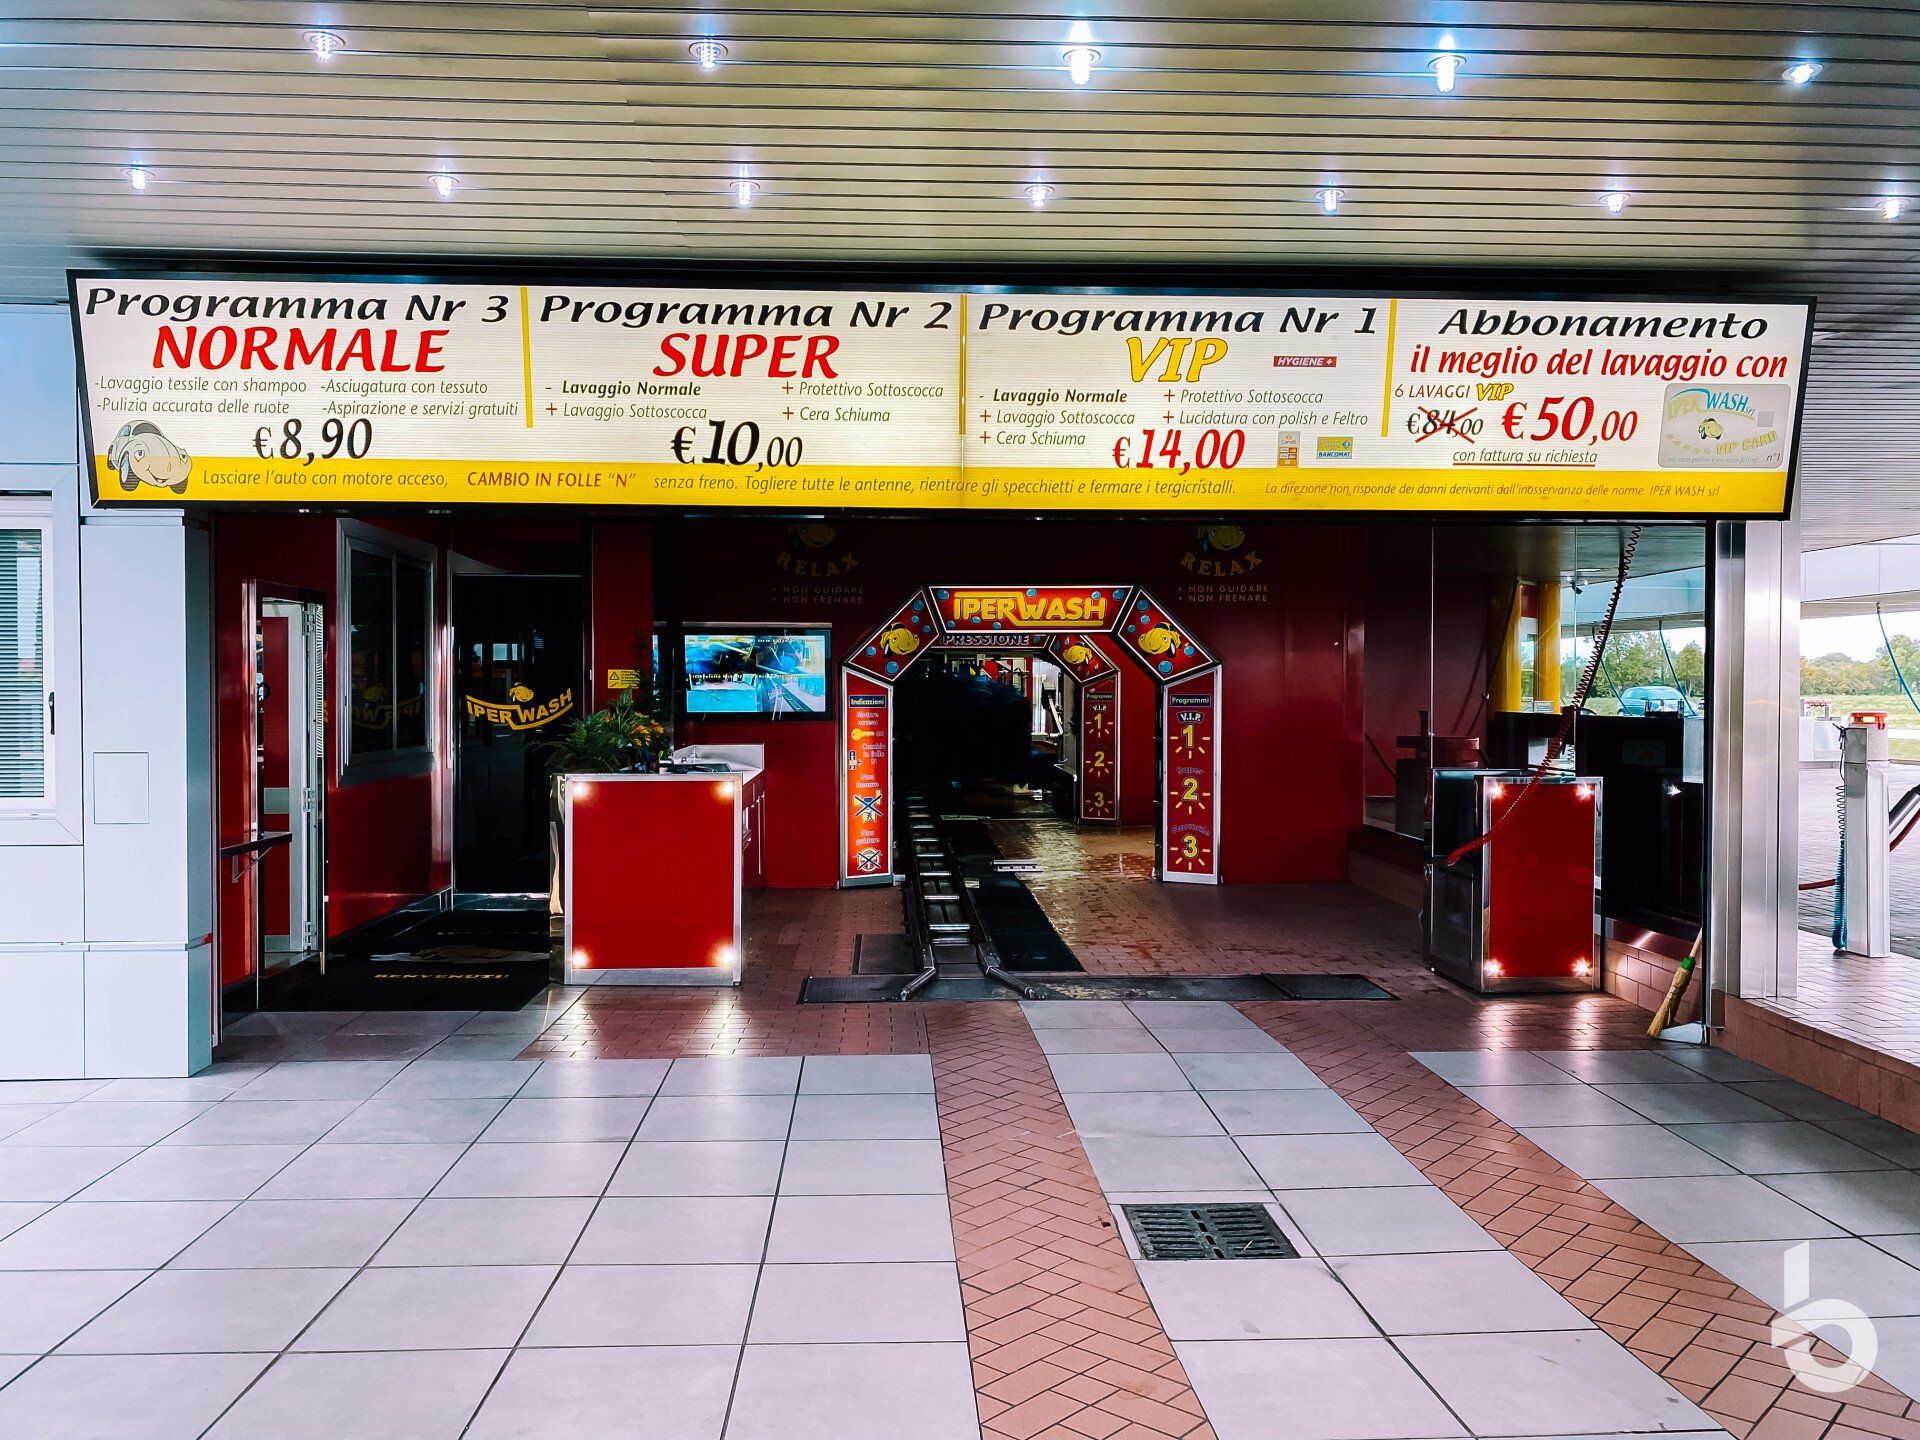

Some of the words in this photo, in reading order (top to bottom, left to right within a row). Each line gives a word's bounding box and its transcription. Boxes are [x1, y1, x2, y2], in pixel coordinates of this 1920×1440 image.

[86, 288, 387, 322] Programma
[405, 295, 466, 321] Nr
[481, 296, 508, 322] 3
[540, 296, 833, 328] Programma
[850, 301, 909, 327] Nr
[924, 302, 952, 329] 2
[979, 304, 1264, 335] Programma
[1280, 308, 1339, 333] Nr
[1354, 308, 1376, 334] 1
[1438, 309, 1767, 339] Abbonamento
[153, 326, 449, 372] NORMALE
[653, 333, 839, 379] SUPER
[1126, 337, 1228, 383] VIP
[1277, 357, 1324, 367] HYGIENE
[1411, 344, 1430, 372] il
[1438, 346, 1538, 378] meglio
[1547, 348, 1593, 375] del
[1601, 349, 1727, 381] lavaggio
[1736, 356, 1787, 377] con
[169, 377, 208, 390] tessile
[214, 381, 237, 391] con
[243, 377, 306, 396] shampoo
[412, 383, 435, 393] con
[441, 381, 487, 393] tessuto
[563, 381, 630, 398] Lavaggio
[637, 382, 701, 395] Normale
[799, 382, 862, 396] Protettivo
[867, 383, 943, 397] Sottoscocca
[1395, 384, 1403, 397] 6
[1409, 385, 1470, 398] LAVAGGI
[1476, 383, 1514, 401] VIP
[993, 389, 1059, 406] Lavaggio
[1065, 389, 1127, 402] Normale
[1181, 389, 1242, 402] Protettivo
[1247, 390, 1323, 403] Sottoscocca
[1666, 393, 1703, 420] IPER
[1705, 389, 1750, 412] WASH
[153, 400, 212, 412] accurata
[218, 399, 249, 413] delle
[254, 402, 289, 414] ruote
[411, 405, 417, 414] e
[423, 401, 464, 415] servizi
[469, 402, 518, 419] gratuiti
[564, 403, 624, 421] Lavaggio
[629, 404, 707, 418] Sottoscocca
[800, 407, 829, 420] Cera
[835, 407, 890, 421] Schiuma
[997, 410, 1054, 427] Lavaggio
[1060, 410, 1135, 424] Sottoscocca
[1180, 410, 1248, 424] Lucidatura
[1252, 415, 1275, 424] con
[1278, 411, 1317, 428] polish
[1322, 415, 1328, 425] e
[1333, 411, 1368, 425] Feltro
[997, 431, 1026, 444] Cera
[1031, 431, 1085, 445] Schiuma
[1716, 442, 1738, 454] VIP
[1742, 430, 1777, 451] CARD
[1453, 451, 1475, 463] con
[1479, 448, 1524, 464] fattura
[1527, 450, 1541, 464] su
[1545, 449, 1598, 464] richiesta
[204, 470, 260, 484] Lasciare
[266, 470, 306, 484] l'auto
[312, 474, 336, 484] con
[343, 473, 392, 485] motore
[398, 475, 447, 487] acceso,
[468, 472, 529, 486] CAMBIO
[536, 473, 551, 486] IN
[557, 473, 601, 487] FOLLE
[654, 478, 693, 488] senza
[699, 475, 737, 489] freno.
[745, 476, 797, 494] Togliere
[803, 478, 834, 490] tutte
[839, 477, 850, 490] le
[855, 479, 914, 494] antenne,
[920, 477, 977, 495] rientrare
[982, 478, 999, 496] gli
[1003, 479, 1074, 497] specchietti
[1078, 483, 1085, 493] e
[1090, 479, 1142, 493] fermare
[1155, 480, 1234, 498] tergicristalli.
[1266, 483, 1277, 494] La
[1280, 484, 1326, 494] direzione
[1330, 484, 1350, 494] non
[1352, 484, 1396, 496] risponde
[1400, 484, 1414, 494] dei
[1417, 484, 1447, 494] danni
[1450, 484, 1493, 495] derivanti
[1586, 485, 1607, 495] delle
[1650, 486, 1671, 495] IPER
[1675, 486, 1704, 496] WASH
[776, 551, 859, 577] RELAX
[1180, 551, 1262, 577] RELAX
[783, 586, 808, 594] NON
[814, 586, 864, 594] GUIDARE
[1188, 585, 1213, 593] NON
[1220, 585, 1268, 593] GUIDARE
[783, 596, 808, 604] NON
[814, 596, 863, 604] FRENARE
[942, 635, 1030, 646] PRESSIONE
[466, 700, 513, 724] IPER
[517, 688, 571, 723] WASH
[851, 698, 884, 706] Indicazioni
[1095, 714, 1102, 730] 1
[1182, 724, 1194, 748] 1
[1094, 751, 1104, 766] 2
[1183, 778, 1198, 800] 2
[1094, 792, 1104, 808] 3
[1183, 835, 1198, 858] 3
